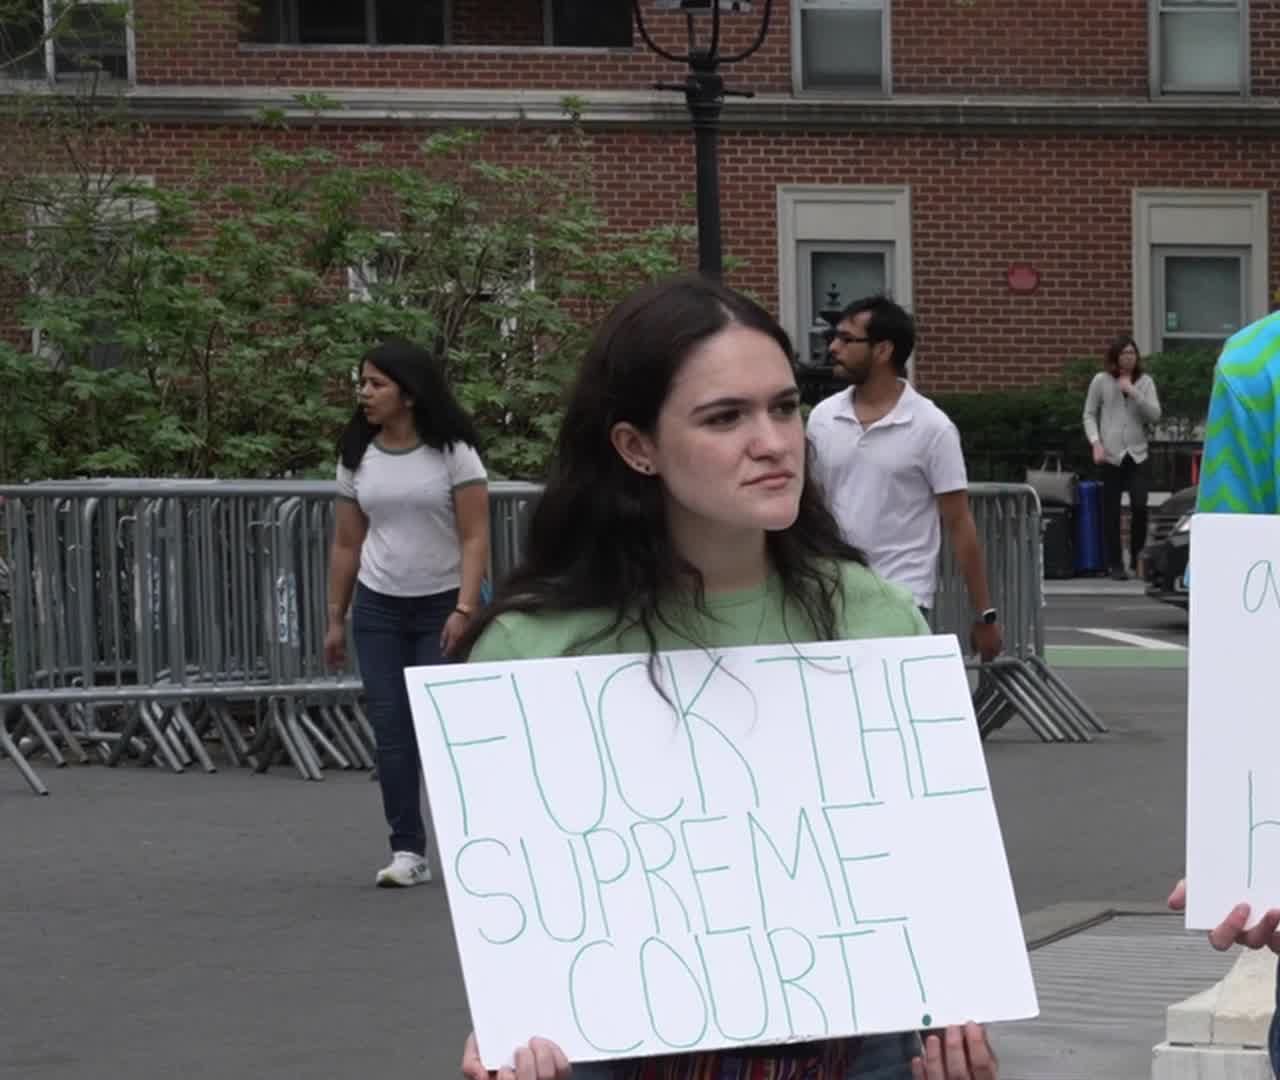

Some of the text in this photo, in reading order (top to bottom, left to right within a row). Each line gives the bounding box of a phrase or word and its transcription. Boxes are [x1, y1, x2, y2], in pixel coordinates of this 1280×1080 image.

[424, 653, 988, 837] FUCK THE
[454, 801, 909, 944] SUPREME
[568, 925, 933, 1053] COURT!
